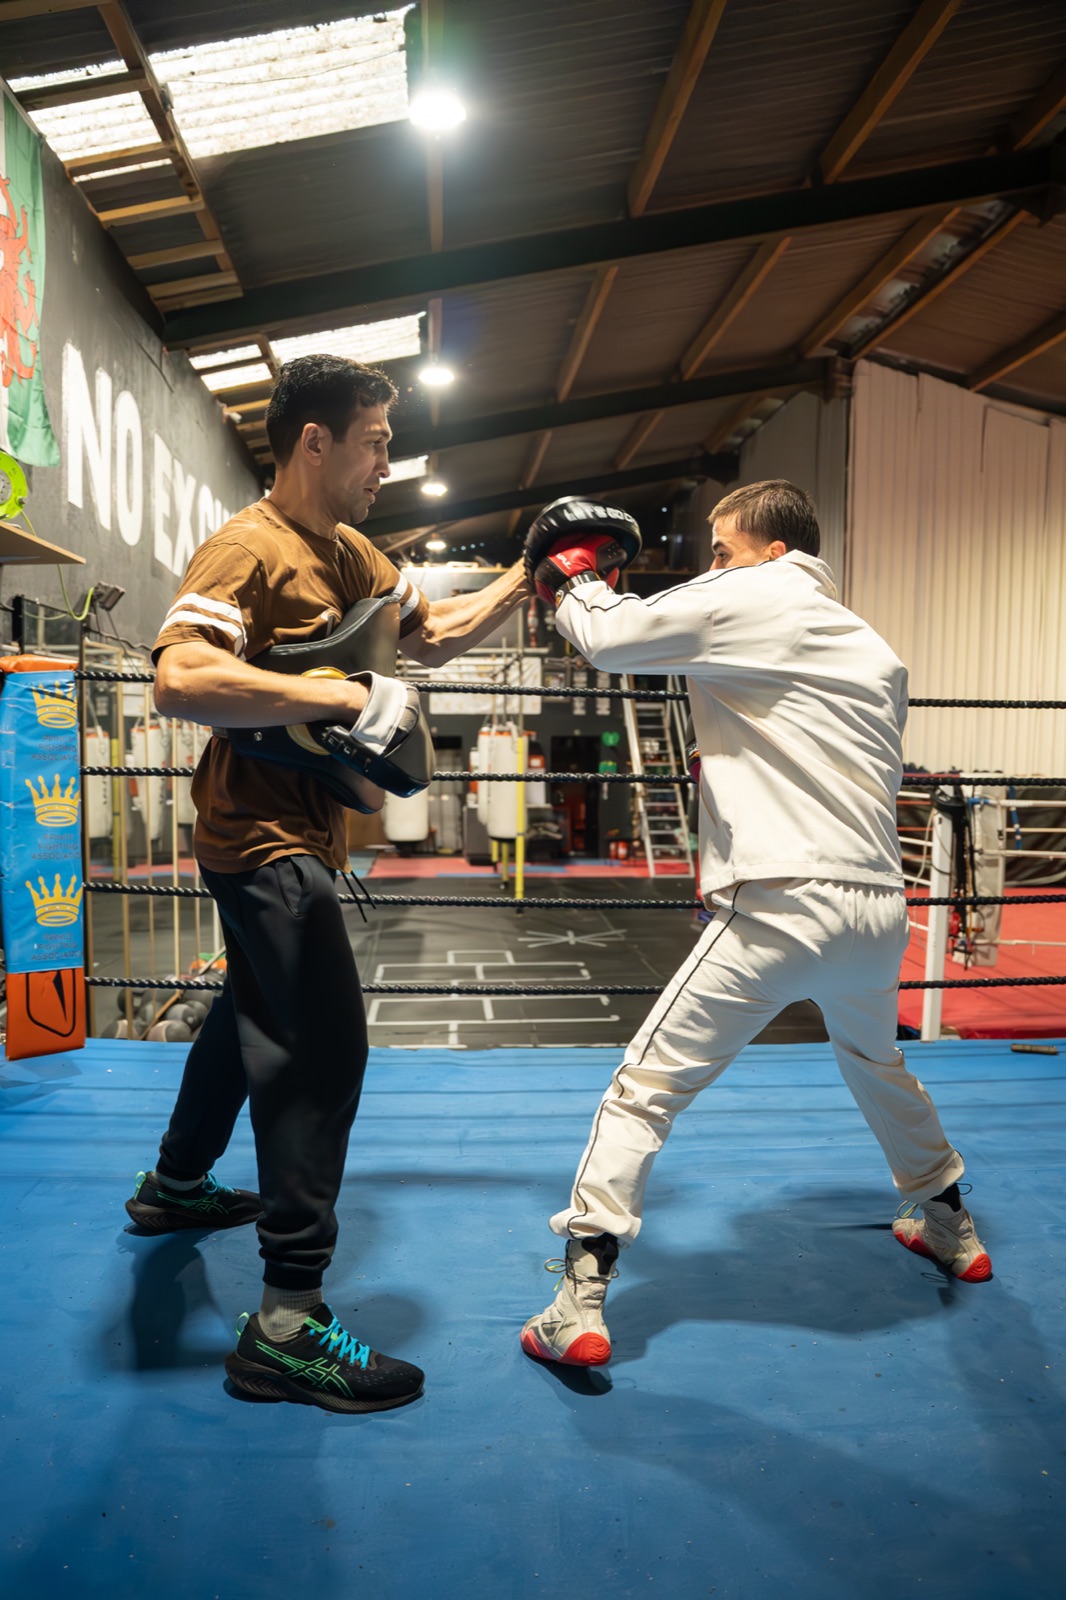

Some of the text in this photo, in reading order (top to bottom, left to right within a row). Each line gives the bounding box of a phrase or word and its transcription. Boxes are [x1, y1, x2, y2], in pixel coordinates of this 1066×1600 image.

[62, 340, 144, 546] NO
[555, 552, 572, 570] VAL
[43, 833, 73, 841] PRINCE
[38, 842, 78, 851] FIGHTING
